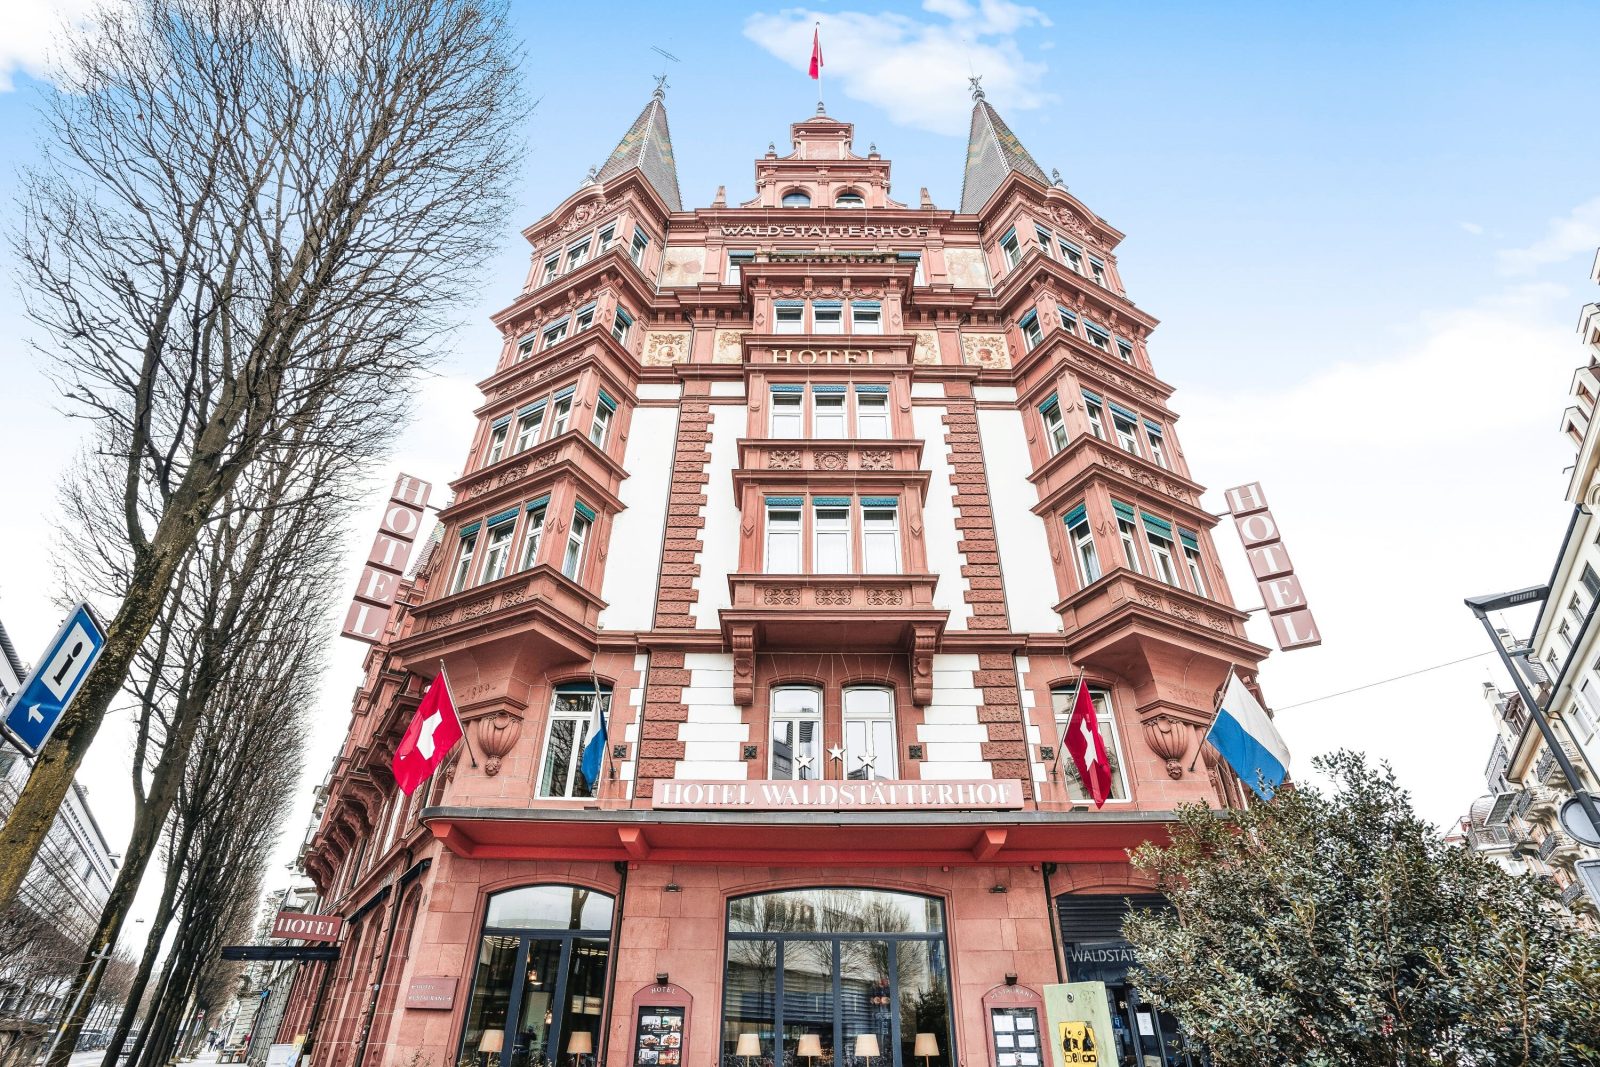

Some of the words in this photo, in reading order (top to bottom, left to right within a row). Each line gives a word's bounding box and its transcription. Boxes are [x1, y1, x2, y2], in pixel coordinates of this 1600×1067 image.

[771, 349, 887, 364] HOTEL
[348, 476, 428, 638] HOTEL
[1231, 485, 1314, 645] HOTEL
[661, 783, 755, 805] HOTEL
[760, 781, 1012, 805] WALDSTÄTTERHOF
[275, 918, 337, 937] HOTEL
[651, 986, 676, 994] HOTEL
